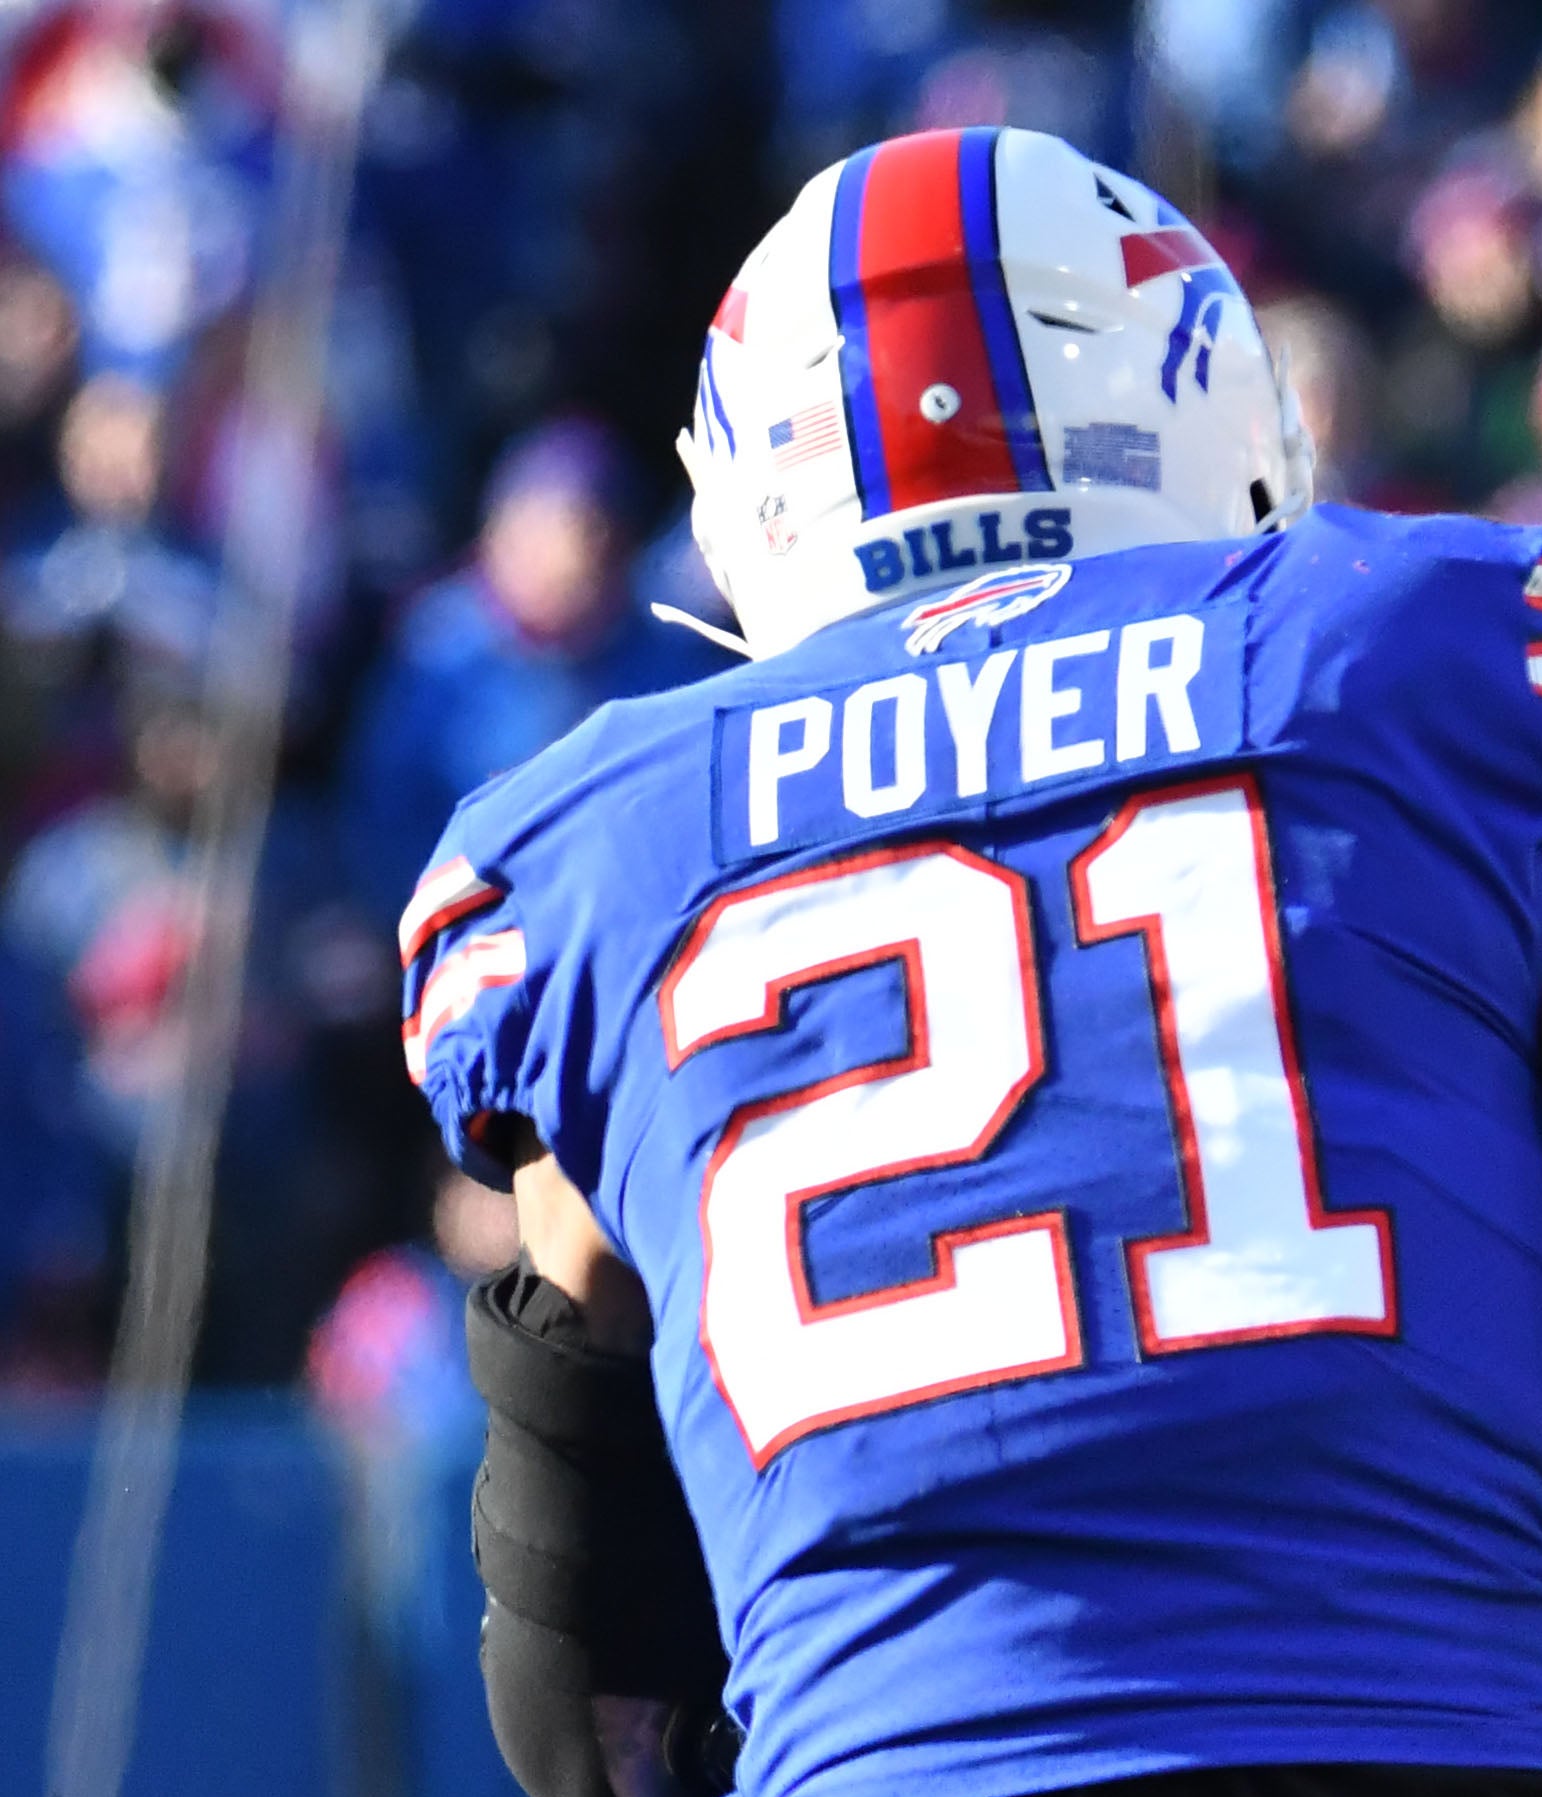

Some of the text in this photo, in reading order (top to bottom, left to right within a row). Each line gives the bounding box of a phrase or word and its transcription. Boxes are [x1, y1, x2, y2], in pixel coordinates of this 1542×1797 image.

[854, 508, 1074, 594] BILLS
[748, 613, 1204, 846] POYER
[658, 771, 1397, 1472] 21
